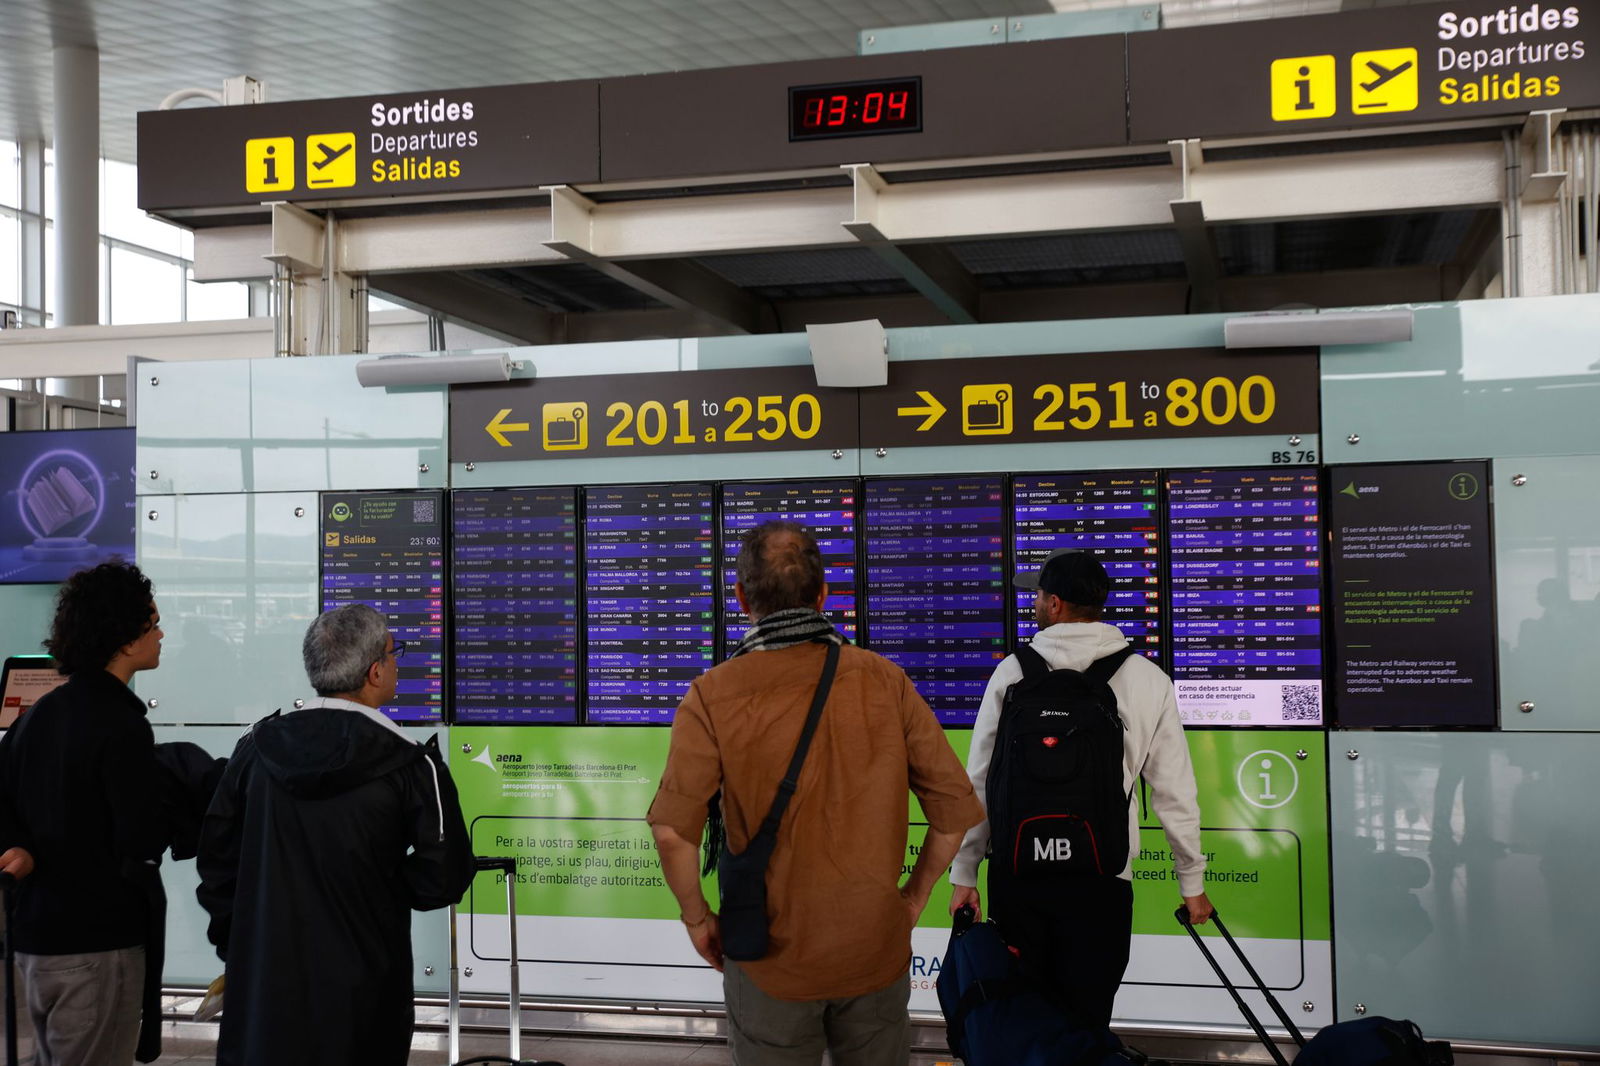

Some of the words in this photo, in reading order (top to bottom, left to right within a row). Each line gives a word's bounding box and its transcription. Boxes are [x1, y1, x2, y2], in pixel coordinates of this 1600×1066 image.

[1437, 3, 1579, 40] Sortides
[1438, 39, 1585, 72] Departures
[1439, 72, 1561, 105] Salidas
[371, 98, 474, 126] Sortides
[816, 92, 908, 126] 13:04
[371, 130, 478, 155] Departures
[372, 156, 460, 182] Salidas
[1140, 381, 1160, 399] to
[702, 400, 719, 416] to
[1033, 381, 1134, 432] 251
[1164, 375, 1276, 427] 800
[606, 399, 696, 447] 201
[724, 393, 822, 442] 250
[1144, 409, 1158, 427] a
[704, 425, 716, 442] a
[1272, 451, 1291, 464] BS
[1296, 451, 1315, 463] 76
[343, 536, 376, 544] Salidas
[496, 754, 522, 762] aena
[496, 835, 514, 847] Per
[517, 838, 523, 847] a
[527, 836, 536, 848] la
[539, 838, 573, 848] vostra
[577, 839, 631, 851] seguretat
[634, 839, 637, 848] i
[640, 839, 650, 849] la
[1034, 838, 1072, 861] MB
[557, 856, 566, 866] si
[569, 857, 581, 867] us
[585, 856, 611, 868] plau,
[615, 856, 661, 870] dirigiu-v
[1140, 849, 1165, 861] that
[496, 873, 527, 885] pts
[530, 873, 598, 887] d'embalatge
[601, 874, 665, 887] autoritzats.
[1132, 869, 1166, 880] ceed
[1205, 870, 1258, 883] thorized
[912, 956, 942, 976] RA
